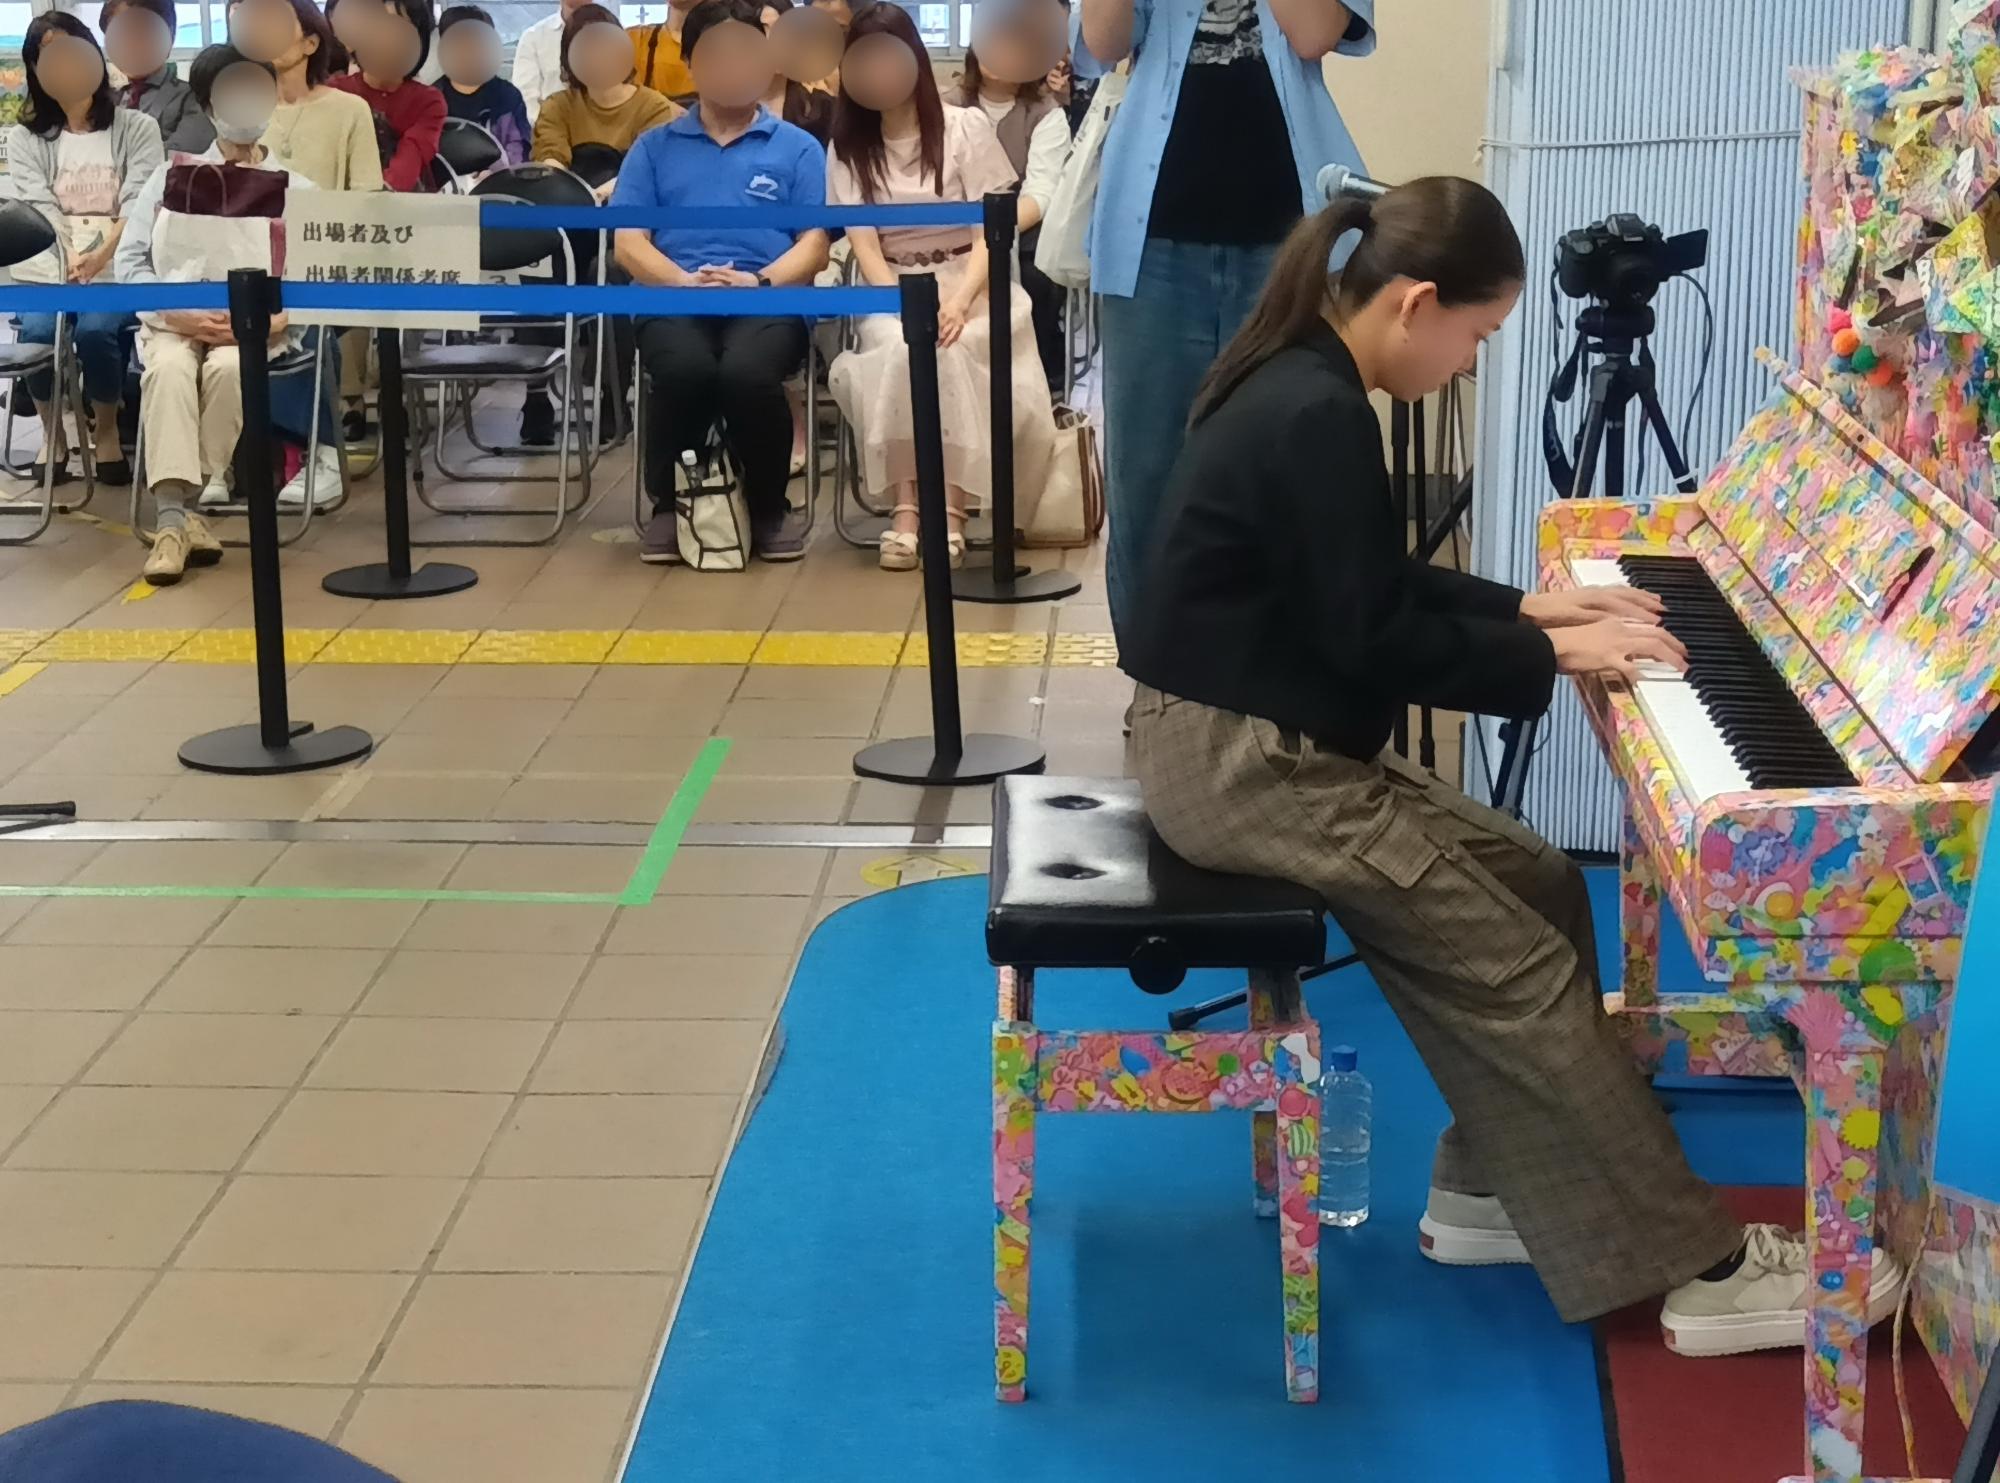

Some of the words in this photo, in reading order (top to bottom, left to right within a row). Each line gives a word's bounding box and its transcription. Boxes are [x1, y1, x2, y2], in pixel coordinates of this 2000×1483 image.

[303, 221, 413, 244] 出場者及び
